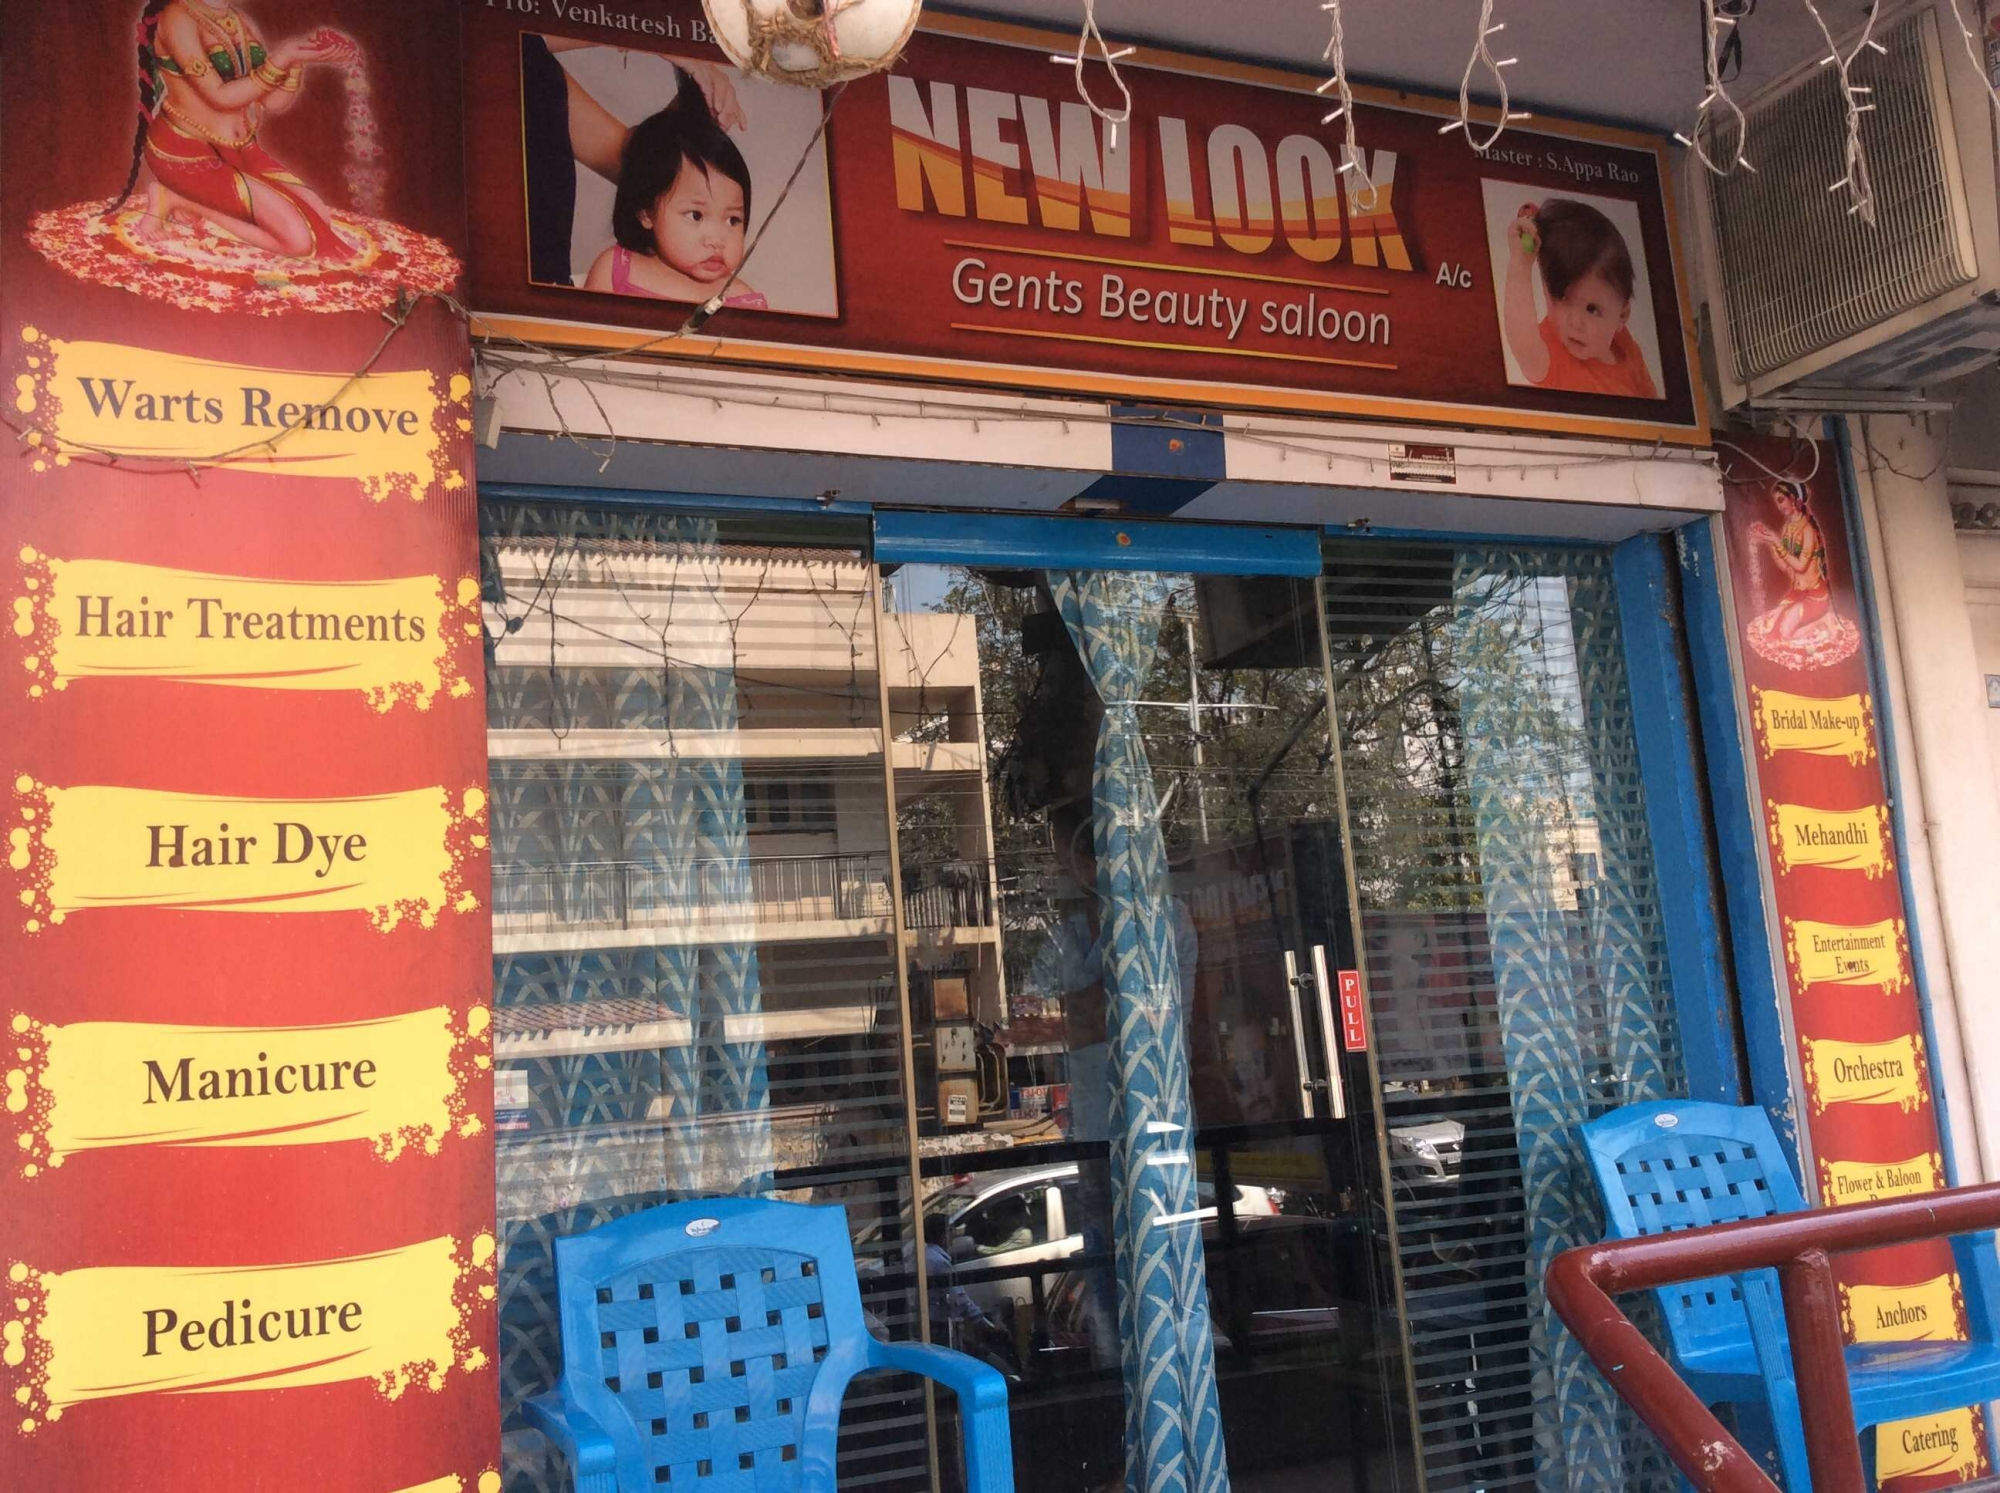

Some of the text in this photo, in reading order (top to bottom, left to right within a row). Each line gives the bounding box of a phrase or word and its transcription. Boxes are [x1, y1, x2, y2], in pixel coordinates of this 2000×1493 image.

[552, 0, 680, 38] Venkatesh
[690, 20, 719, 45] Ba
[887, 75, 1414, 271] NEW LOOK
[1546, 153, 1603, 181] S.Appa
[1608, 162, 1639, 182] Rao
[1435, 262, 1472, 288] A/c
[951, 258, 1391, 345] Gents Beauty saloon
[76, 376, 418, 436] Warts Remove
[75, 595, 425, 642] Hair Treatments
[1771, 710, 1860, 736] Bridal Make-up
[145, 822, 367, 878] Hair Dye
[1794, 823, 1868, 847] Mehandhi
[1813, 934, 1885, 953] Entertainment
[1835, 957, 1869, 973] Evnts
[1345, 979, 1361, 1041] PULL
[142, 1051, 377, 1105] Manicure
[1833, 1056, 1903, 1084] Orchestra
[1837, 1168, 1922, 1194] Flower & Baloon
[142, 1299, 362, 1356] Pedicure
[1876, 1301, 1927, 1329] Anchors
[1902, 1424, 1958, 1456] Catering
